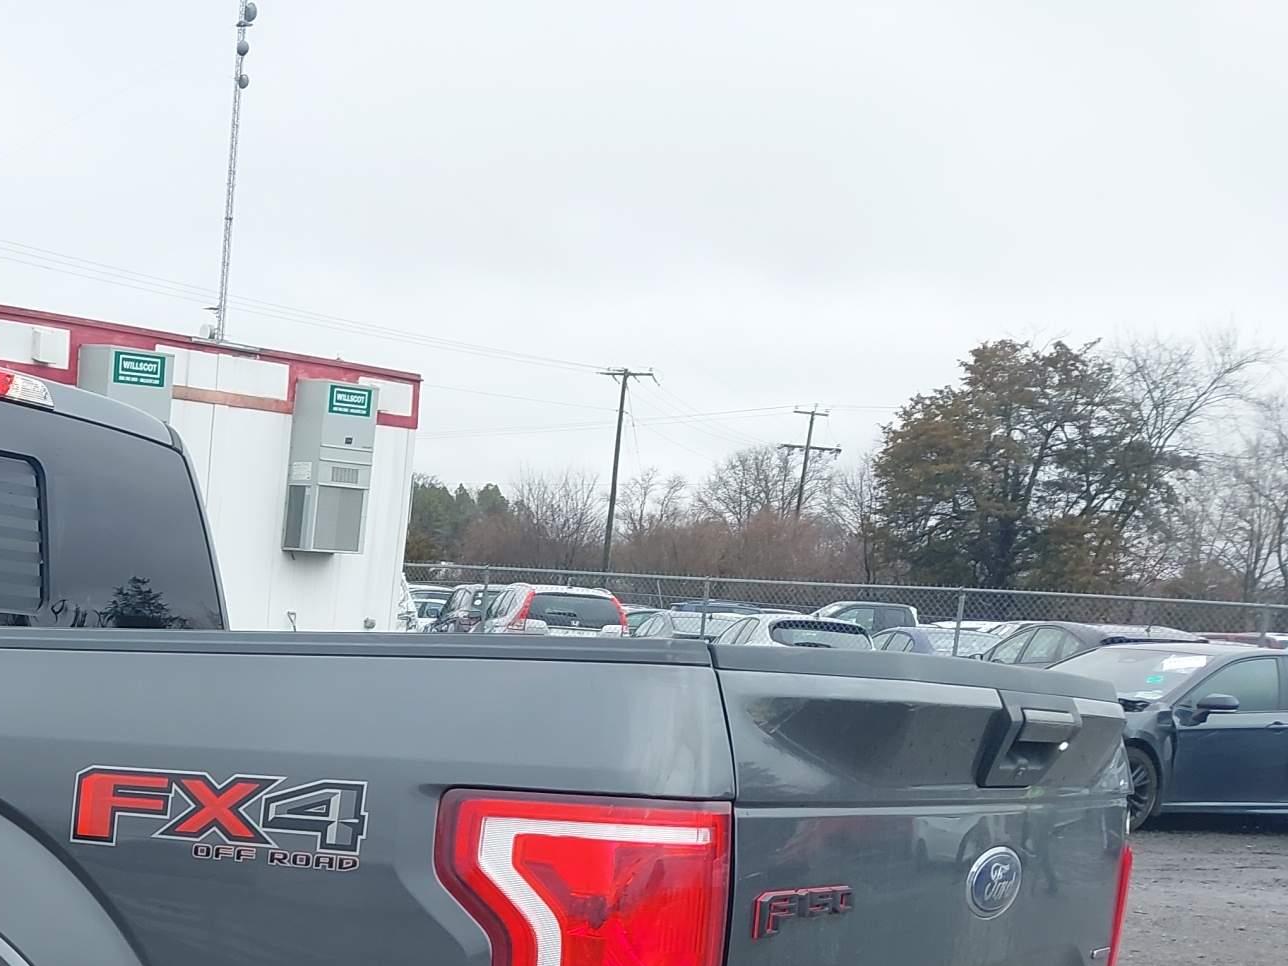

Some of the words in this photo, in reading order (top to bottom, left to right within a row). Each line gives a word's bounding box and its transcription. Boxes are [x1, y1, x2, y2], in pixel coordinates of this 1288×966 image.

[122, 360, 158, 373] WILLSCOT
[336, 393, 365, 404] WILLSCOT
[70, 765, 368, 855] FX4
[192, 843, 257, 862] OFF
[267, 849, 360, 872] ROAD
